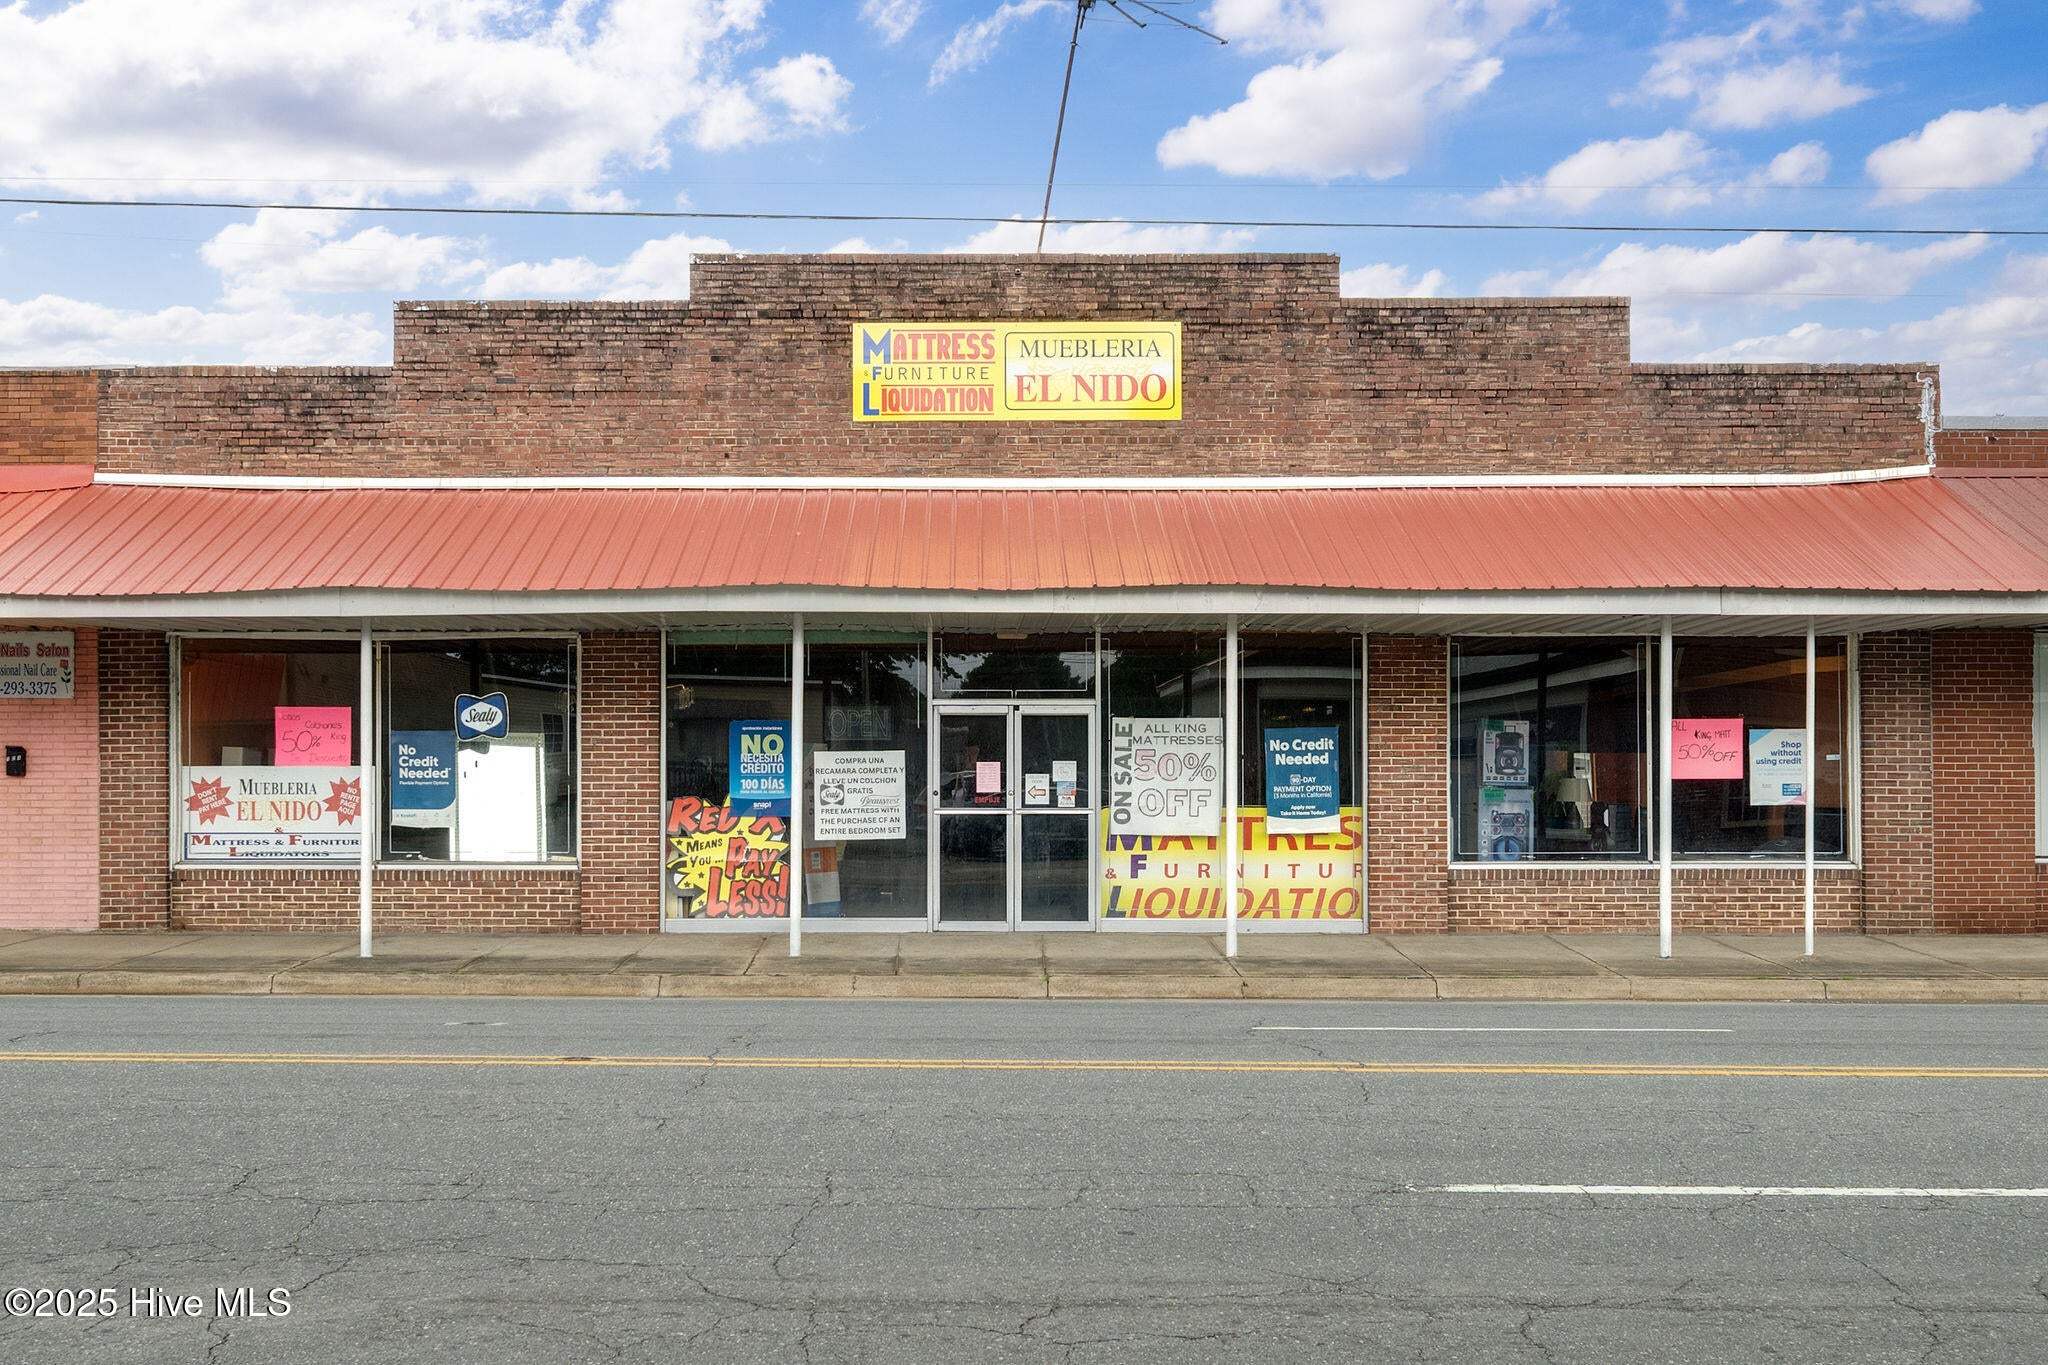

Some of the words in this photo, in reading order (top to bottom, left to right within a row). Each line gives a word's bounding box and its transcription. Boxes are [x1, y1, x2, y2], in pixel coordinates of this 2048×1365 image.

[863, 328, 996, 364] MATTRESS
[1020, 339, 1161, 358] MUEBLERIA
[872, 366, 989, 381] FURNITURE
[1014, 374, 1062, 402] EL
[1072, 373, 1167, 402] NIDO
[863, 383, 994, 416] LIQUIDATION
[0, 643, 30, 657] Nails
[36, 643, 70, 657] Salon
[24, 663, 38, 676] Nail
[41, 662, 57, 676] Care
[0, 681, 57, 695] -293-3375
[465, 707, 498, 726] Sealy
[829, 709, 887, 737] OPEN
[1144, 724, 1170, 733] ALL
[1174, 724, 1207, 733] KING
[281, 730, 321, 753] 50%
[741, 733, 784, 755] NO
[1132, 735, 1223, 745] MATTRESSES
[1269, 739, 1290, 752] No
[1291, 738, 1335, 751] Credit
[398, 744, 416, 755] No
[1113, 723, 1133, 786] SALE
[1678, 743, 1716, 759] 50%
[1713, 751, 1739, 762] OFF
[398, 755, 439, 767] Credit
[740, 753, 785, 763] NECESITA
[1133, 748, 1217, 782] 50%
[1275, 752, 1329, 766] Needed
[1755, 758, 1777, 766] using
[740, 762, 785, 774] CRÉDITO
[815, 767, 857, 775] RECAMARA
[240, 779, 317, 795] MUEBLERIA
[740, 779, 758, 789] 100
[761, 777, 785, 789] DÍAS
[1273, 785, 1305, 793] PAYMENT
[1305, 785, 1332, 793] OPTION
[197, 787, 218, 800] DON'T
[341, 792, 361, 803] RENTE
[822, 789, 841, 801] Sealy
[846, 787, 874, 795] GRATIS
[199, 804, 211, 813] PAY
[210, 798, 228, 809] HERE
[202, 795, 218, 805] RENT
[340, 800, 357, 810] PAGE
[1137, 788, 1212, 817] OFF
[237, 801, 263, 821] EL
[269, 800, 322, 821] NIDO
[1113, 791, 1132, 825] ON
[836, 817, 877, 825] PURCHASE
[887, 826, 901, 834] SET
[191, 835, 270, 846] MATTRESS
[686, 838, 723, 853] MEANS
[229, 847, 330, 857] LIQUIDATORS
[725, 836, 779, 879] PAY
[689, 856, 712, 868] YOU
[1105, 868, 1117, 879] &
[706, 865, 790, 917] LESS!
